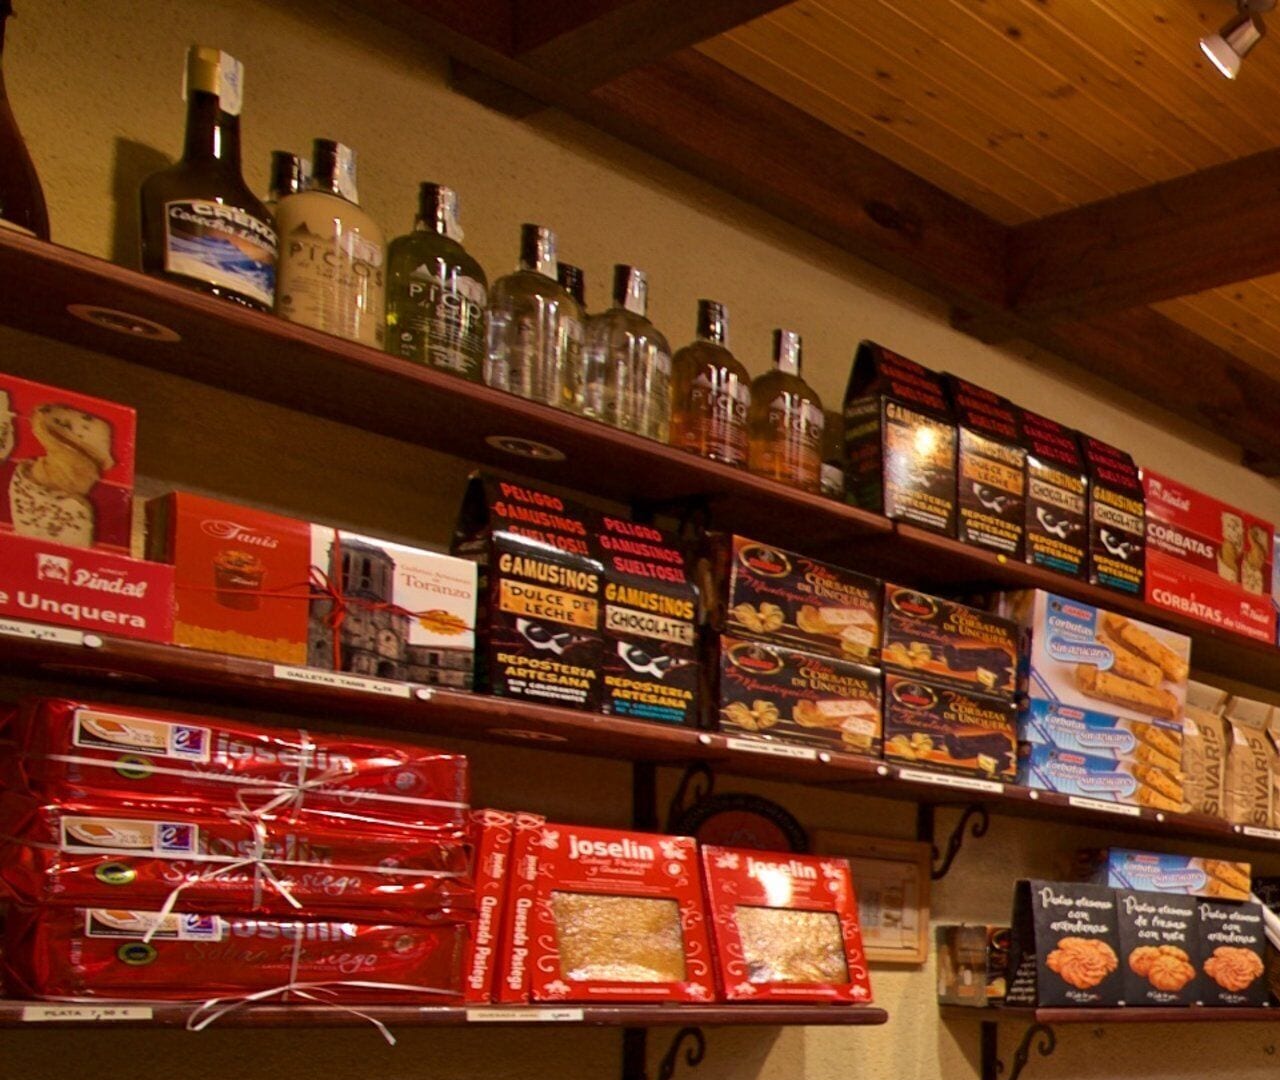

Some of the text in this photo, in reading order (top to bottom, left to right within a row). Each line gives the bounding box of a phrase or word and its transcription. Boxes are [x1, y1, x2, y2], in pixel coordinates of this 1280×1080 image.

[409, 282, 483, 320] PICO
[201, 518, 281, 550] Tanis
[1146, 522, 1214, 559] CORBATAS
[72, 568, 148, 599] Pindal
[400, 573, 471, 600] Toranzo
[804, 572, 870, 599] CORBATAS
[16, 591, 147, 629] Unquera
[509, 585, 592, 613] DULCE DE
[525, 602, 576, 623] LECHE
[610, 611, 688, 640] CHOCOLATE
[1048, 615, 1094, 637] Corbatas
[1151, 587, 1270, 640] CORBATAS de Unquera
[287, 671, 335, 684] GALLETAS
[504, 666, 591, 689] ARTESANA
[799, 666, 868, 690] CORBATAS
[810, 678, 877, 700] UNQUERA
[610, 688, 688, 710] ARTESANA
[1201, 724, 1220, 818] SIVARIS
[1249, 737, 1268, 826] SIVARIS
[568, 834, 655, 861] joselin
[746, 856, 817, 880] joselin
[1067, 910, 1090, 922] con
[1134, 916, 1149, 928] de
[467, 896, 498, 990] Quesada Pasiega
[506, 898, 533, 990] Quesada Pasiega
[1138, 930, 1160, 941] con
